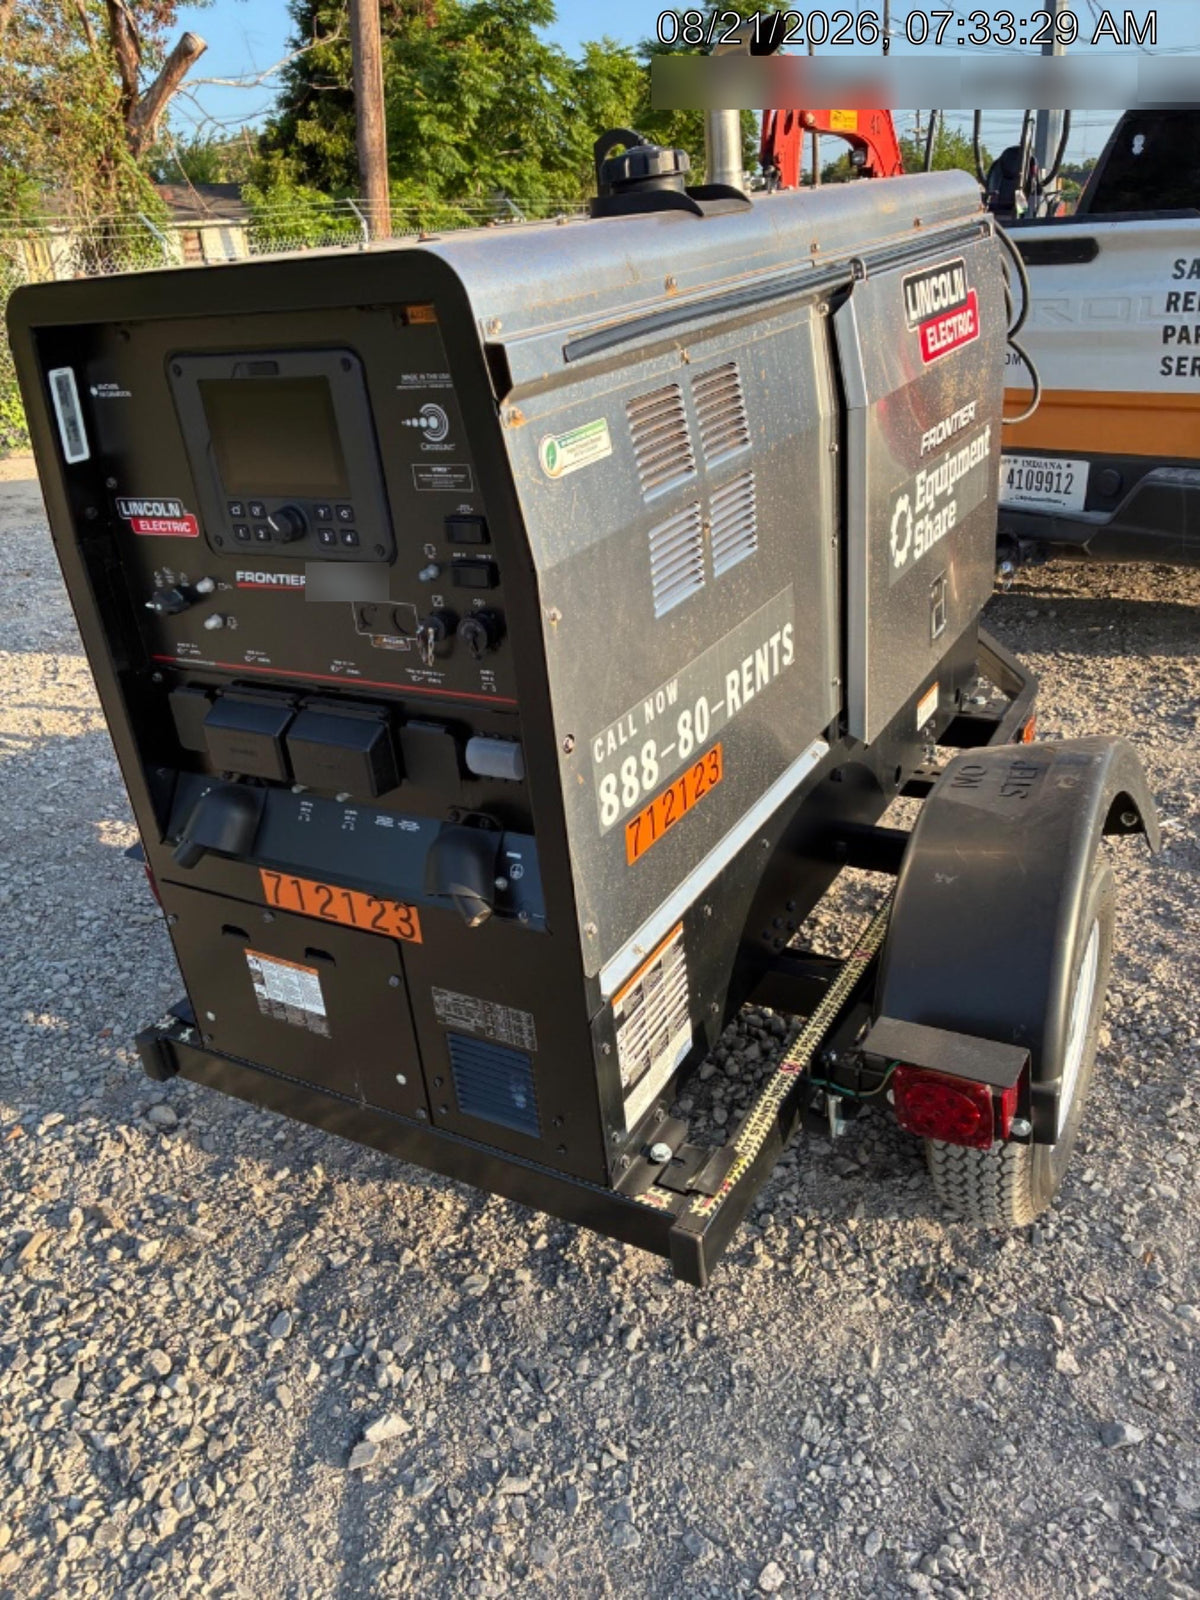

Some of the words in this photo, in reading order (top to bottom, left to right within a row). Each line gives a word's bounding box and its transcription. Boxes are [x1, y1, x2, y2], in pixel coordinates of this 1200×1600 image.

[906, 266, 966, 321] LINCOLN
[926, 309, 975, 354] ELECTRIC
[920, 400, 978, 456] FRONTIER
[915, 424, 991, 515] Equipment
[1006, 467, 1074, 495] 4109912
[1021, 459, 1062, 470] INDIANA
[121, 501, 181, 517] LINCOLN
[138, 520, 191, 532] ELECTRIC
[913, 499, 957, 560] Share
[593, 713, 637, 763] CALL
[643, 678, 679, 725] NOW
[599, 621, 795, 828] 888-80-RENTS
[950, 765, 987, 788] NO
[997, 761, 1039, 799] STEP
[628, 749, 720, 857] 712123
[264, 872, 415, 939] 712123
[751, 1099, 774, 1135] STAND
